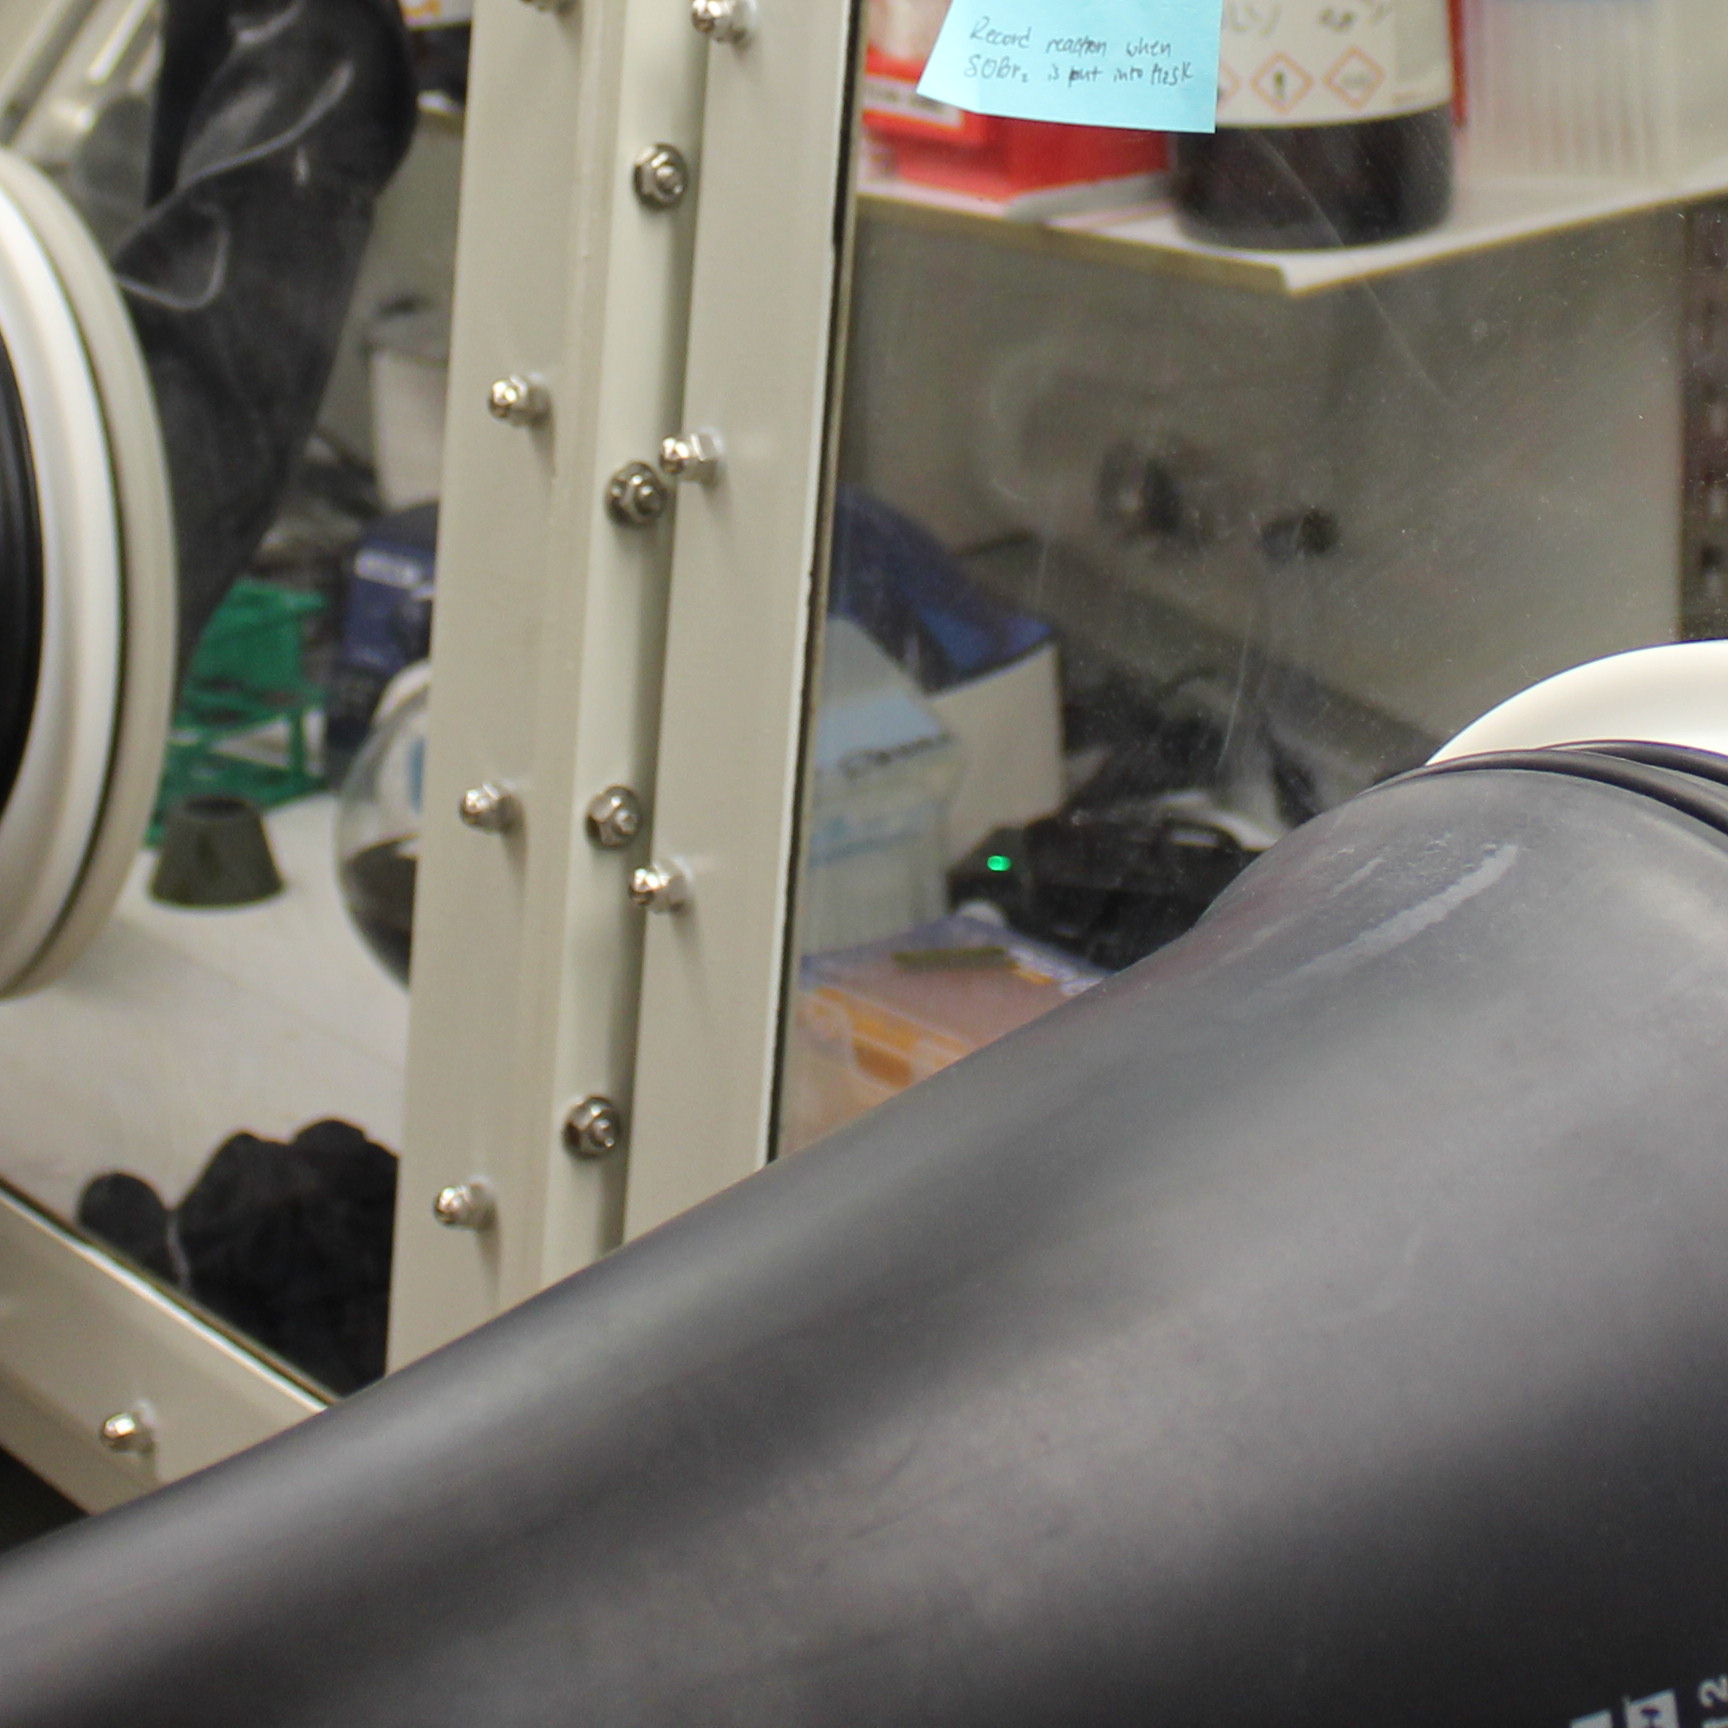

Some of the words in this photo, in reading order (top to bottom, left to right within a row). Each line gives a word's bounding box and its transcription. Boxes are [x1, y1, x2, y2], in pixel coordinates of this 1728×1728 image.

[968, 14, 1033, 52] Record
[1124, 34, 1175, 59] when
[1046, 62, 1062, 82] is
[1067, 64, 1104, 89] put
[1112, 62, 1144, 84] into
